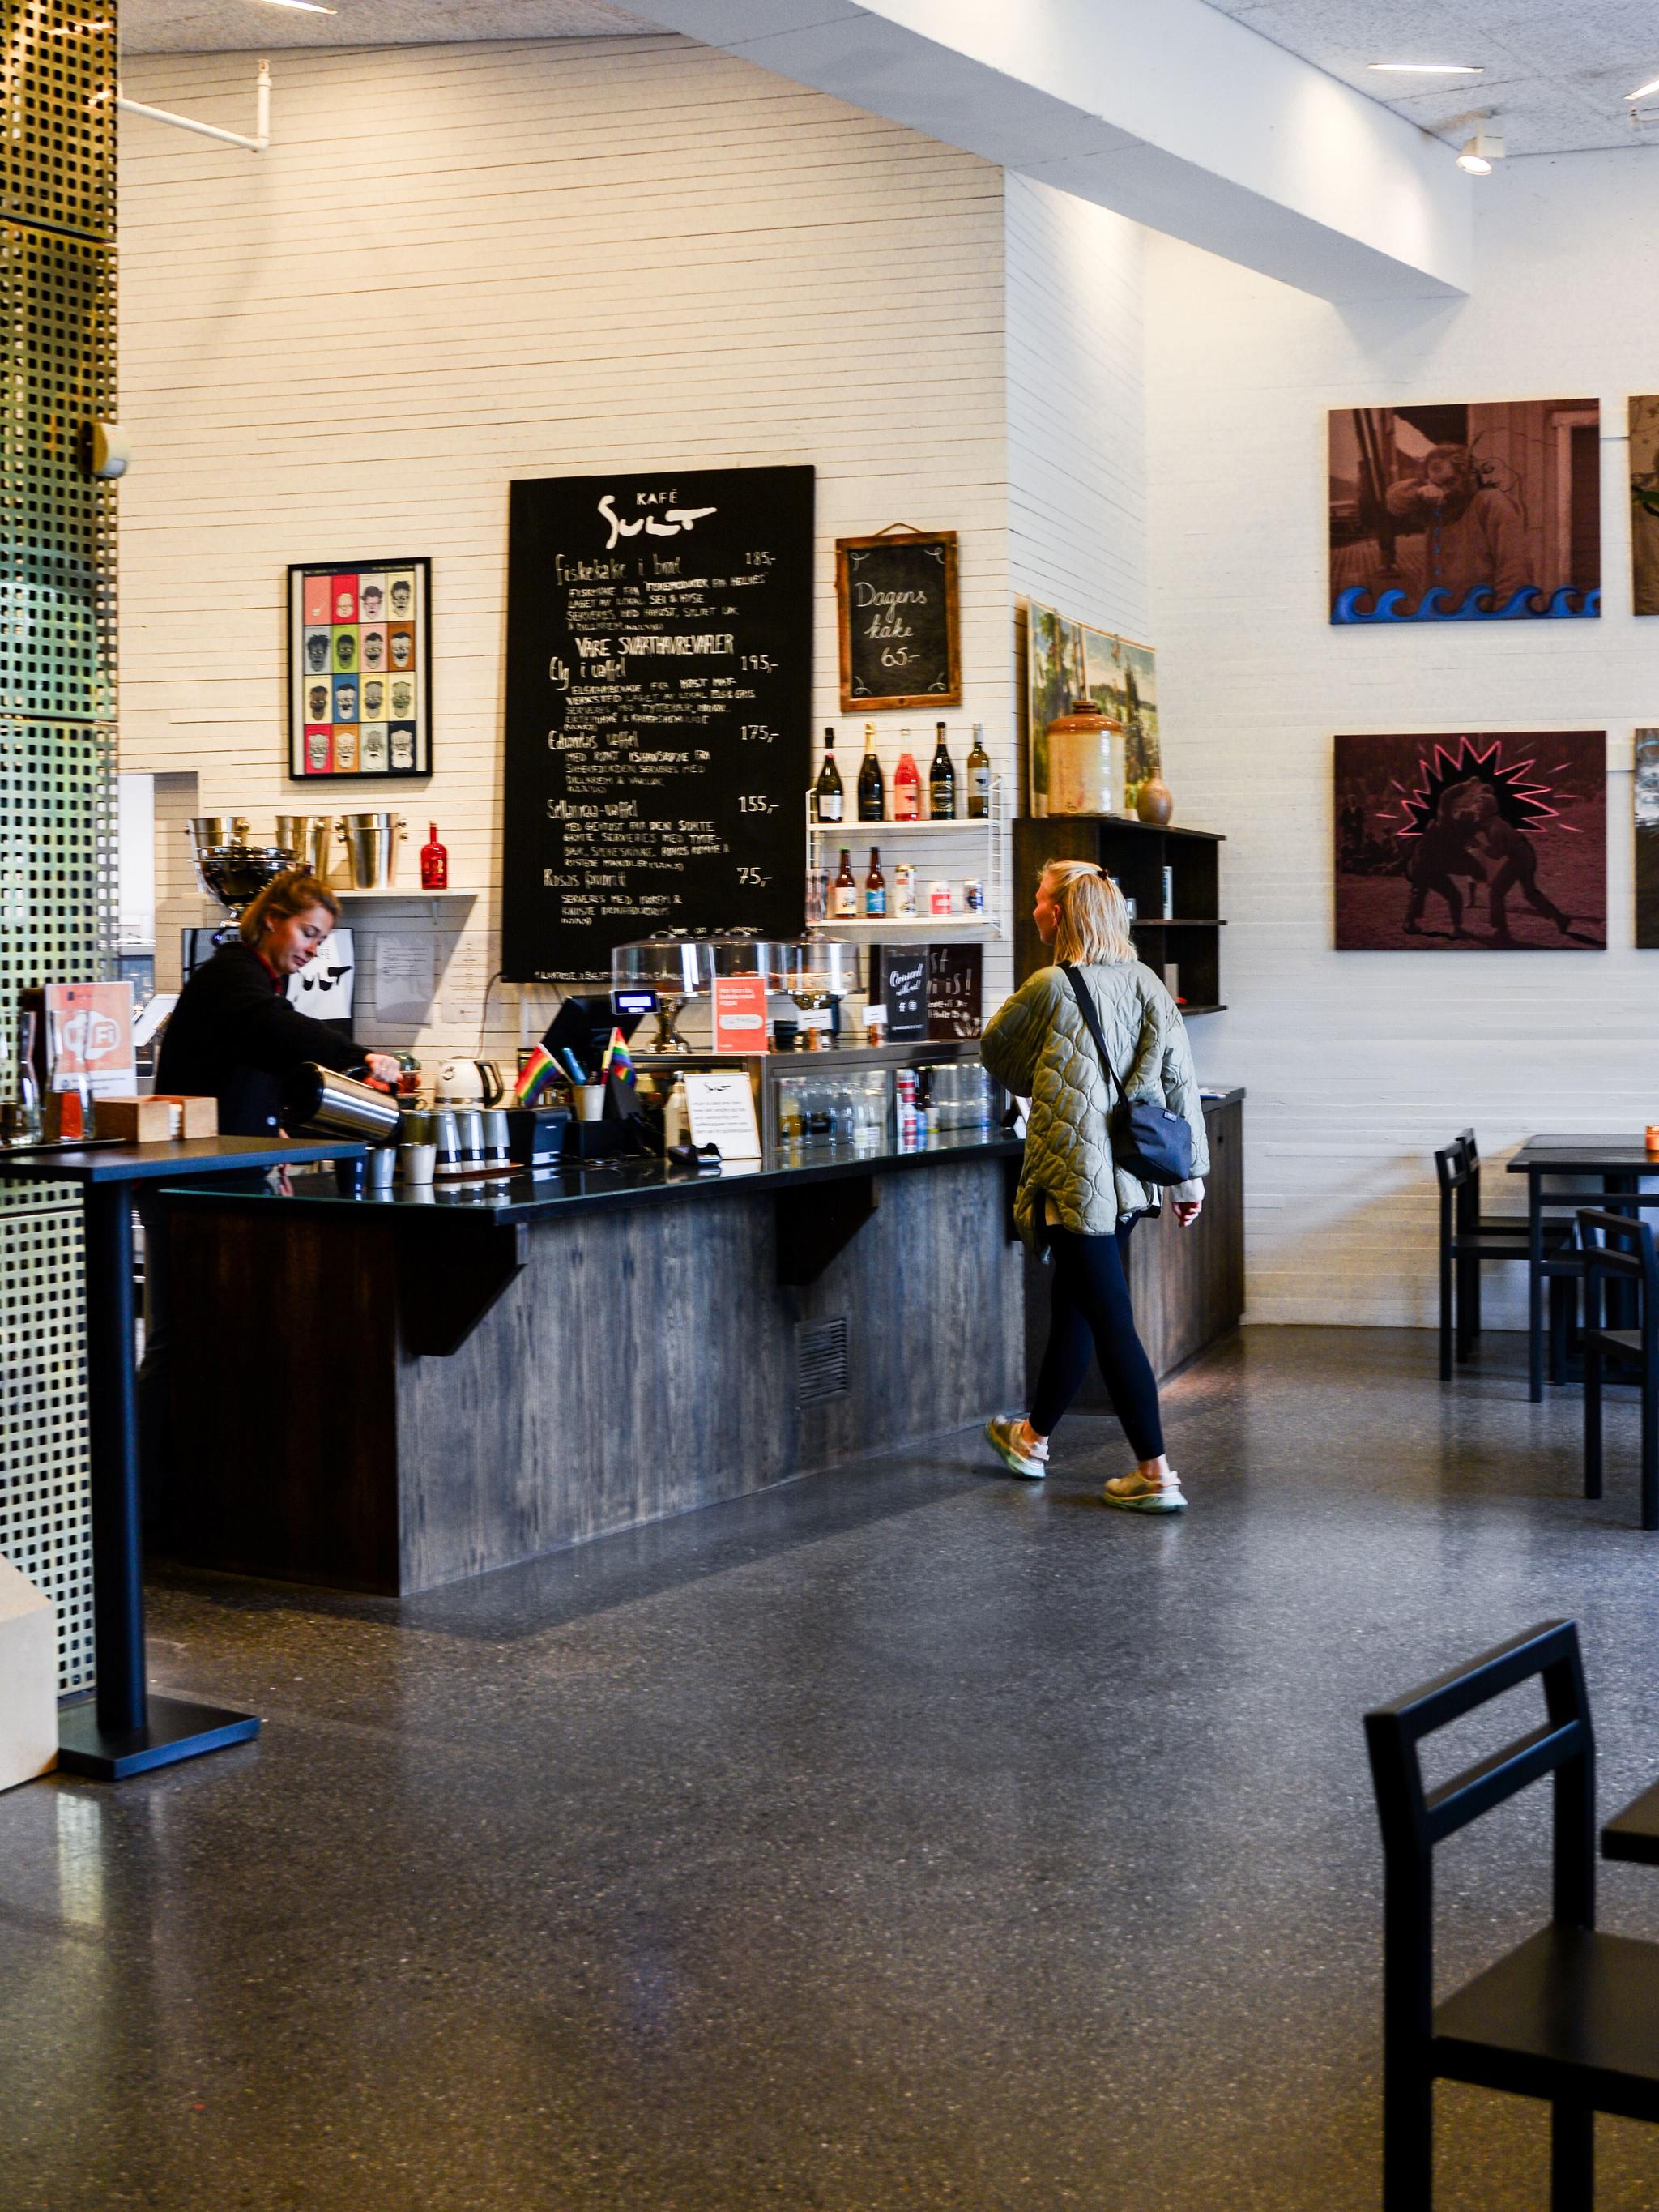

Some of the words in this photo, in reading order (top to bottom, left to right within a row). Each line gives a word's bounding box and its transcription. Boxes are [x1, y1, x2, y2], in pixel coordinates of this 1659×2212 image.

[636, 489, 679, 505] KAFÉ
[638, 559, 645, 576] i
[855, 582, 928, 623] Dagens
[864, 613, 914, 638] kake
[580, 662, 587, 678] i
[740, 725, 780, 743] 175,-
[738, 796, 779, 815] 155,-
[736, 867, 774, 887] 75,-
